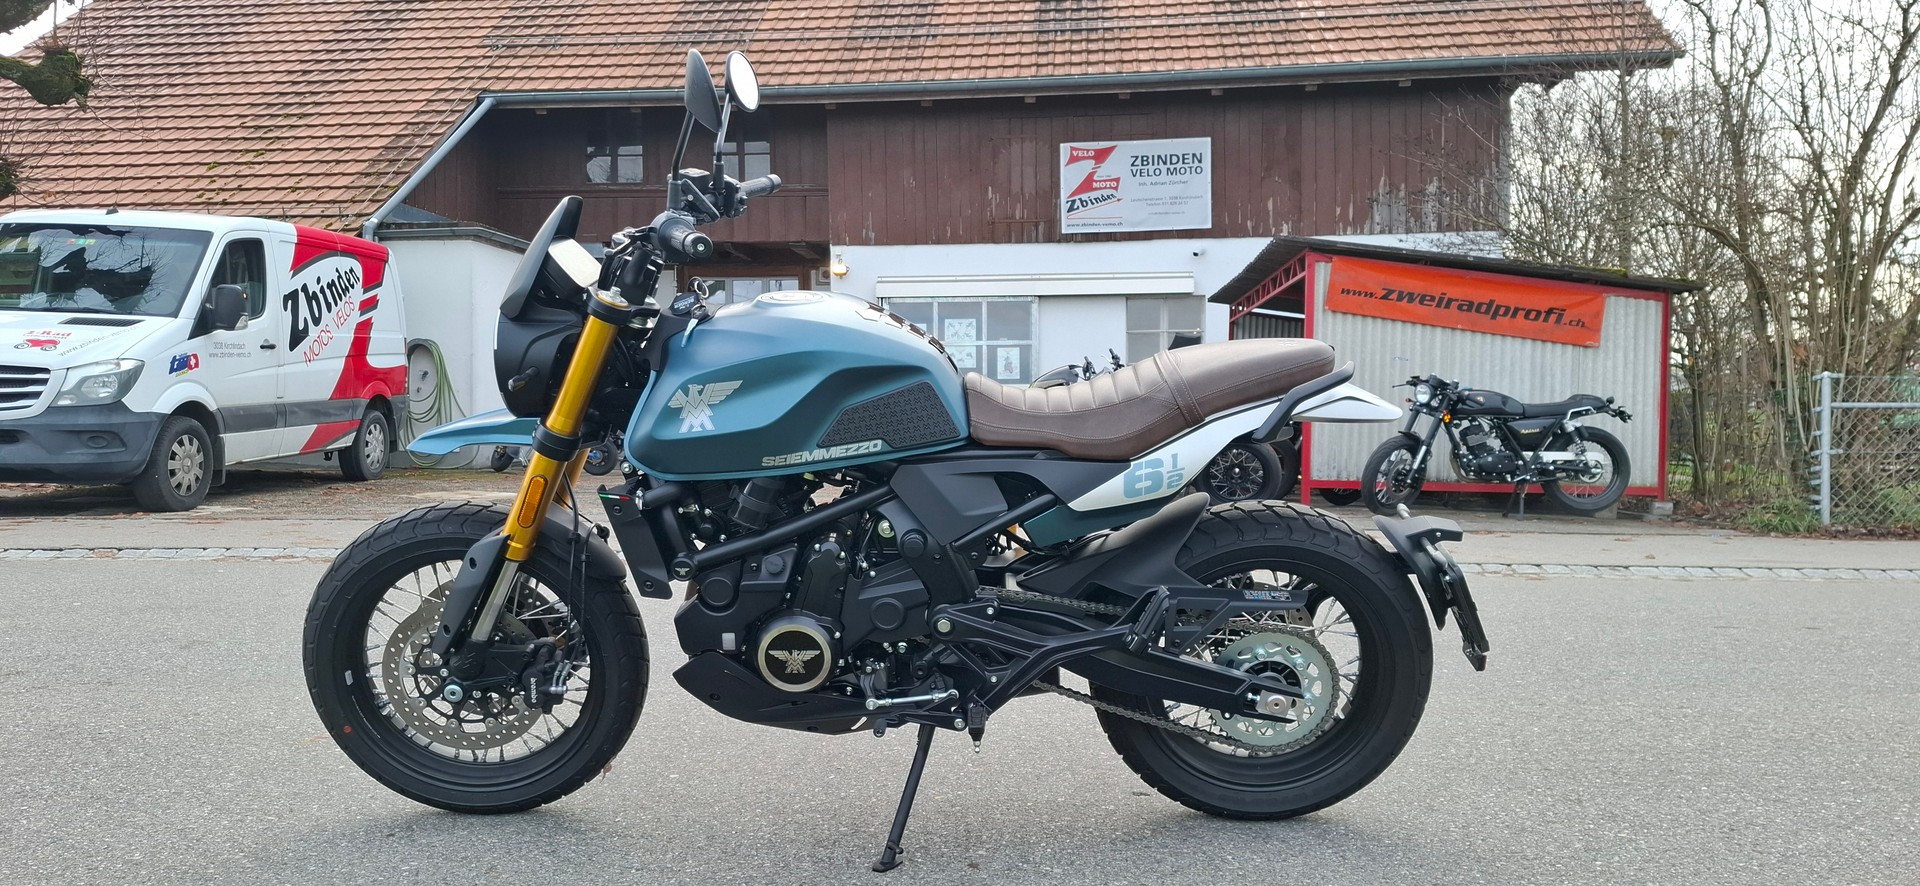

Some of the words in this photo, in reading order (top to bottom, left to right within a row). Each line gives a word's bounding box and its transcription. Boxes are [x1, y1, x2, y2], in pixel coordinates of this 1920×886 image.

[1130, 152, 1203, 167] ZBINDEN
[1130, 167, 1162, 177] VELO
[1166, 165, 1203, 176] MOTO
[1066, 193, 1117, 213] Zbinden
[283, 266, 361, 352] Zbinden
[1340, 287, 1586, 328] www.zweiradprofi.ch
[303, 323, 334, 367] MOTOS
[332, 295, 355, 330] VELOS
[761, 439, 883, 467] SEIEMMEZZO
